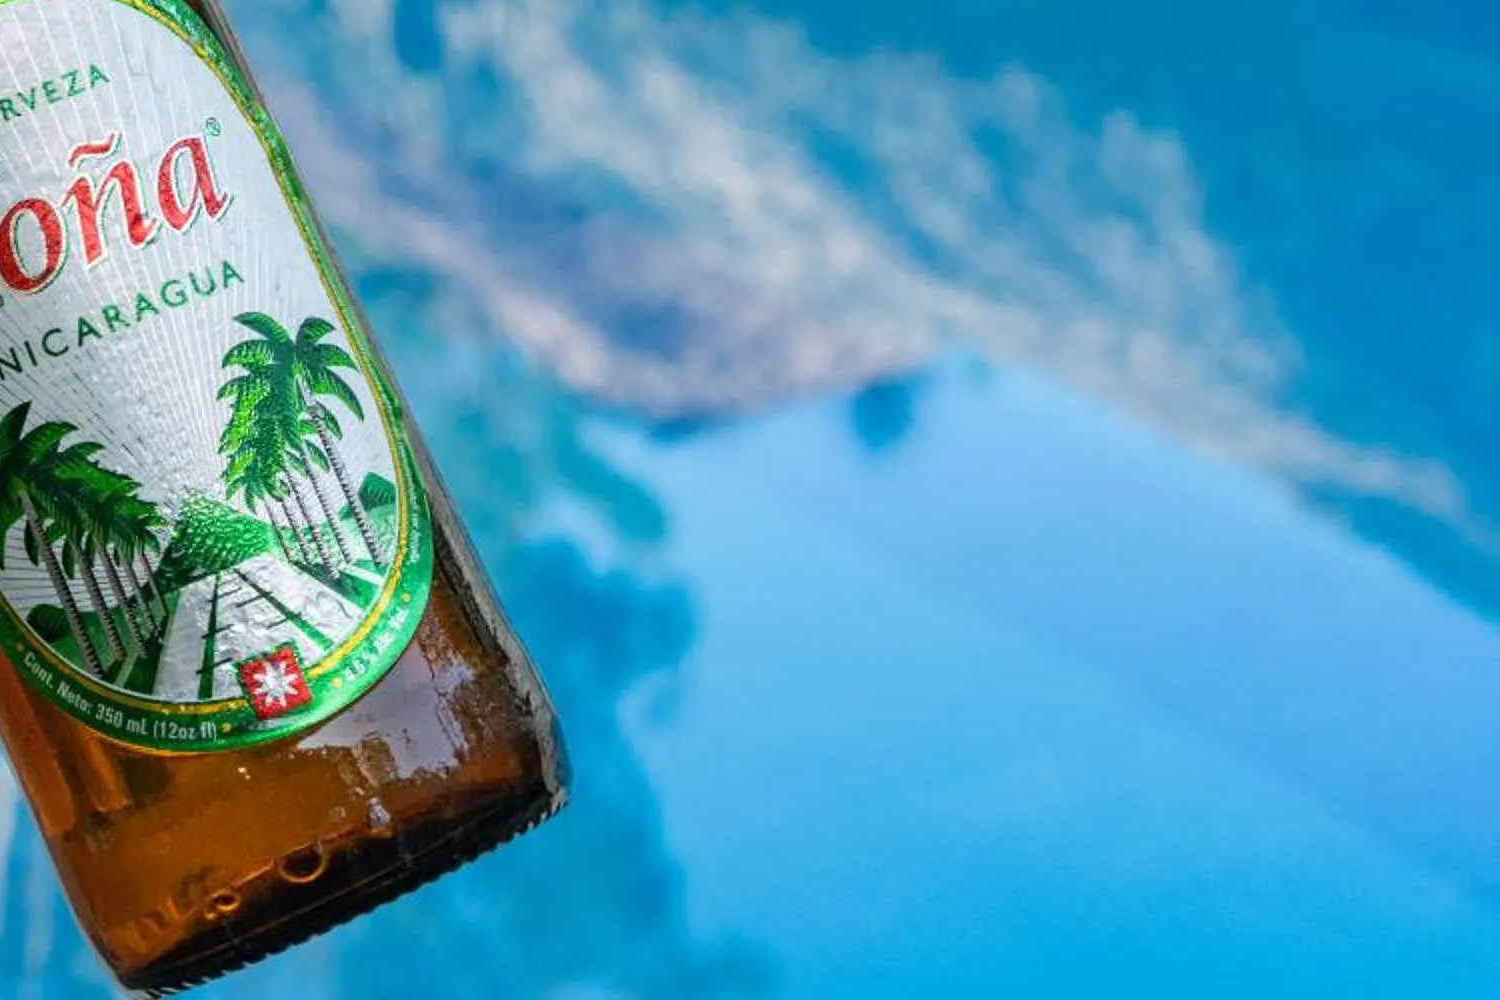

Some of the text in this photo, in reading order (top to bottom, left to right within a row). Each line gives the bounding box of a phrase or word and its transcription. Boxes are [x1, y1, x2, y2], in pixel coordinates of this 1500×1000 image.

[23, 650, 54, 689] Cont.
[94, 703, 123, 730] 350
[125, 718, 148, 736] mL
[152, 720, 197, 742] (12oz
